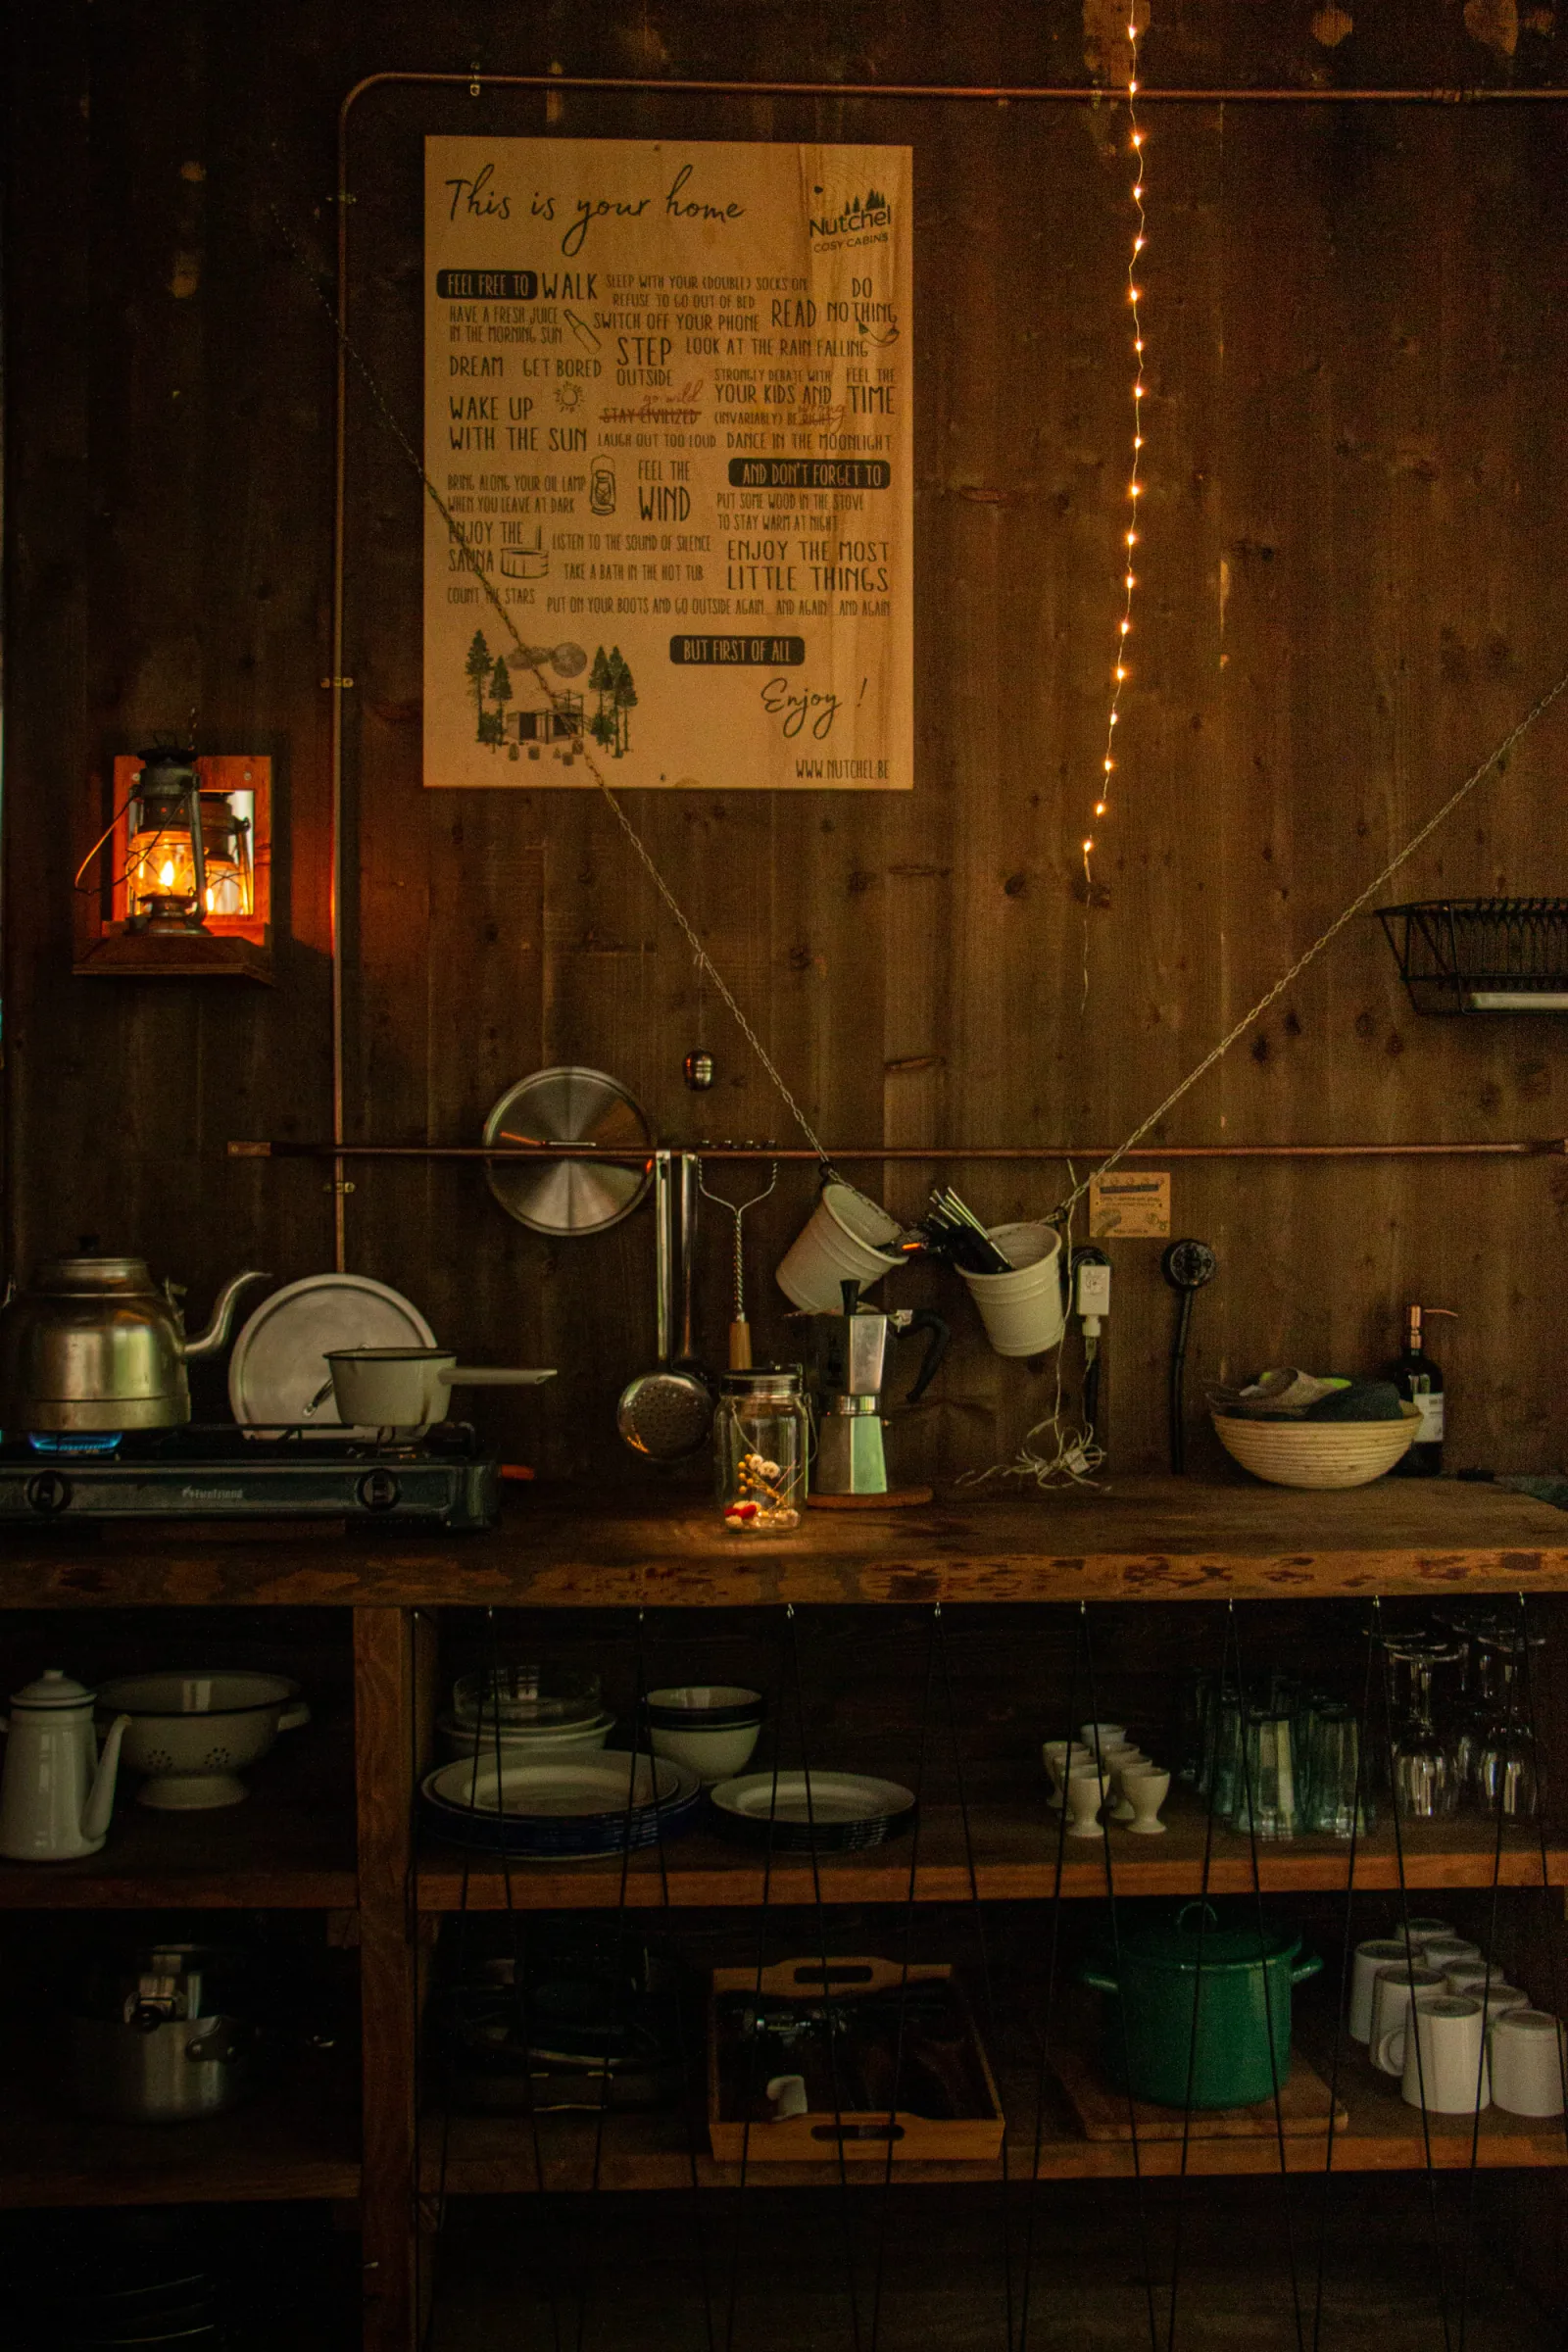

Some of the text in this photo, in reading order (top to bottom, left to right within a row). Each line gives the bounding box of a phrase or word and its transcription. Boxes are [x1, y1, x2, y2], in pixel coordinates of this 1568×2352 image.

[445, 164, 747, 257] This is your home
[809, 204, 891, 237] Nutchel
[812, 232, 889, 253] COSY CABINS
[447, 273, 529, 296] FEEL FREE TO
[542, 272, 599, 300] WALK
[606, 274, 634, 288] SLEEP
[639, 274, 664, 289] WITH
[669, 275, 698, 290] YOUR
[757, 277, 788, 291] SOCKS
[792, 277, 808, 291] ON
[852, 277, 872, 298] DO
[612, 293, 755, 309] REFUSE TO GO OUT OF BED
[450, 306, 558, 324] HAVE A FRESH JUICE
[594, 313, 760, 332] SWITCH OFF YOUR PHONE
[772, 299, 816, 328] READ
[827, 302, 898, 323] NOTHING
[450, 325, 563, 344] IN THE MORNING SUN
[616, 337, 672, 367] STEP
[686, 338, 868, 358] LOOK AT THE RAIN FALLING
[450, 355, 504, 377] DREAM
[522, 358, 602, 378] GET BORED
[808, 369, 832, 382] WITH
[846, 368, 895, 383] FEEL THE
[616, 368, 672, 386] OUTSIDE
[714, 383, 832, 405] YOUR KIDS AND
[847, 385, 896, 415] TIME
[450, 396, 533, 421] WAKE UP
[603, 407, 635, 423] STAY
[787, 413, 797, 425] BE
[449, 426, 587, 452] WITH THE SUN
[637, 433, 659, 447] OUT
[664, 434, 684, 448] TOO
[690, 434, 716, 448] LOUD
[727, 432, 893, 451] DANCE IN THE MOONLIGHT
[638, 460, 690, 481] FEEL THE
[743, 463, 882, 486] AND DON'T FORGET TO
[448, 474, 586, 492] BRING ALONG YOUR OIL LAMP
[448, 496, 575, 514] WHEN YOU LEAVE AT DARK
[638, 486, 691, 521] WIND
[716, 493, 864, 511] PUT SOME WOOD IN THE STOVE
[500, 520, 523, 545] THE
[717, 514, 838, 532] TO STAY WARM AT NIGHT
[553, 533, 710, 552] LISTEN TO THE SOUND OF SILENCE
[728, 540, 890, 562] ENJOY THE MOST
[564, 563, 704, 581] TAKE A BATH IN THE HOT TUB
[728, 565, 889, 592] LITTLE THINGS
[505, 588, 535, 605] STARS
[547, 596, 566, 612] PUT
[570, 597, 584, 612] ON
[588, 597, 613, 612] YOUR
[617, 597, 649, 613] BOOTS
[654, 598, 671, 613] AND
[675, 598, 688, 613] GO
[692, 598, 731, 614] OUTSIDE
[776, 600, 795, 615] AND
[840, 600, 858, 615] AND
[683, 639, 791, 662] BUT FIRST OF ALL
[760, 677, 867, 740] Enjoy !
